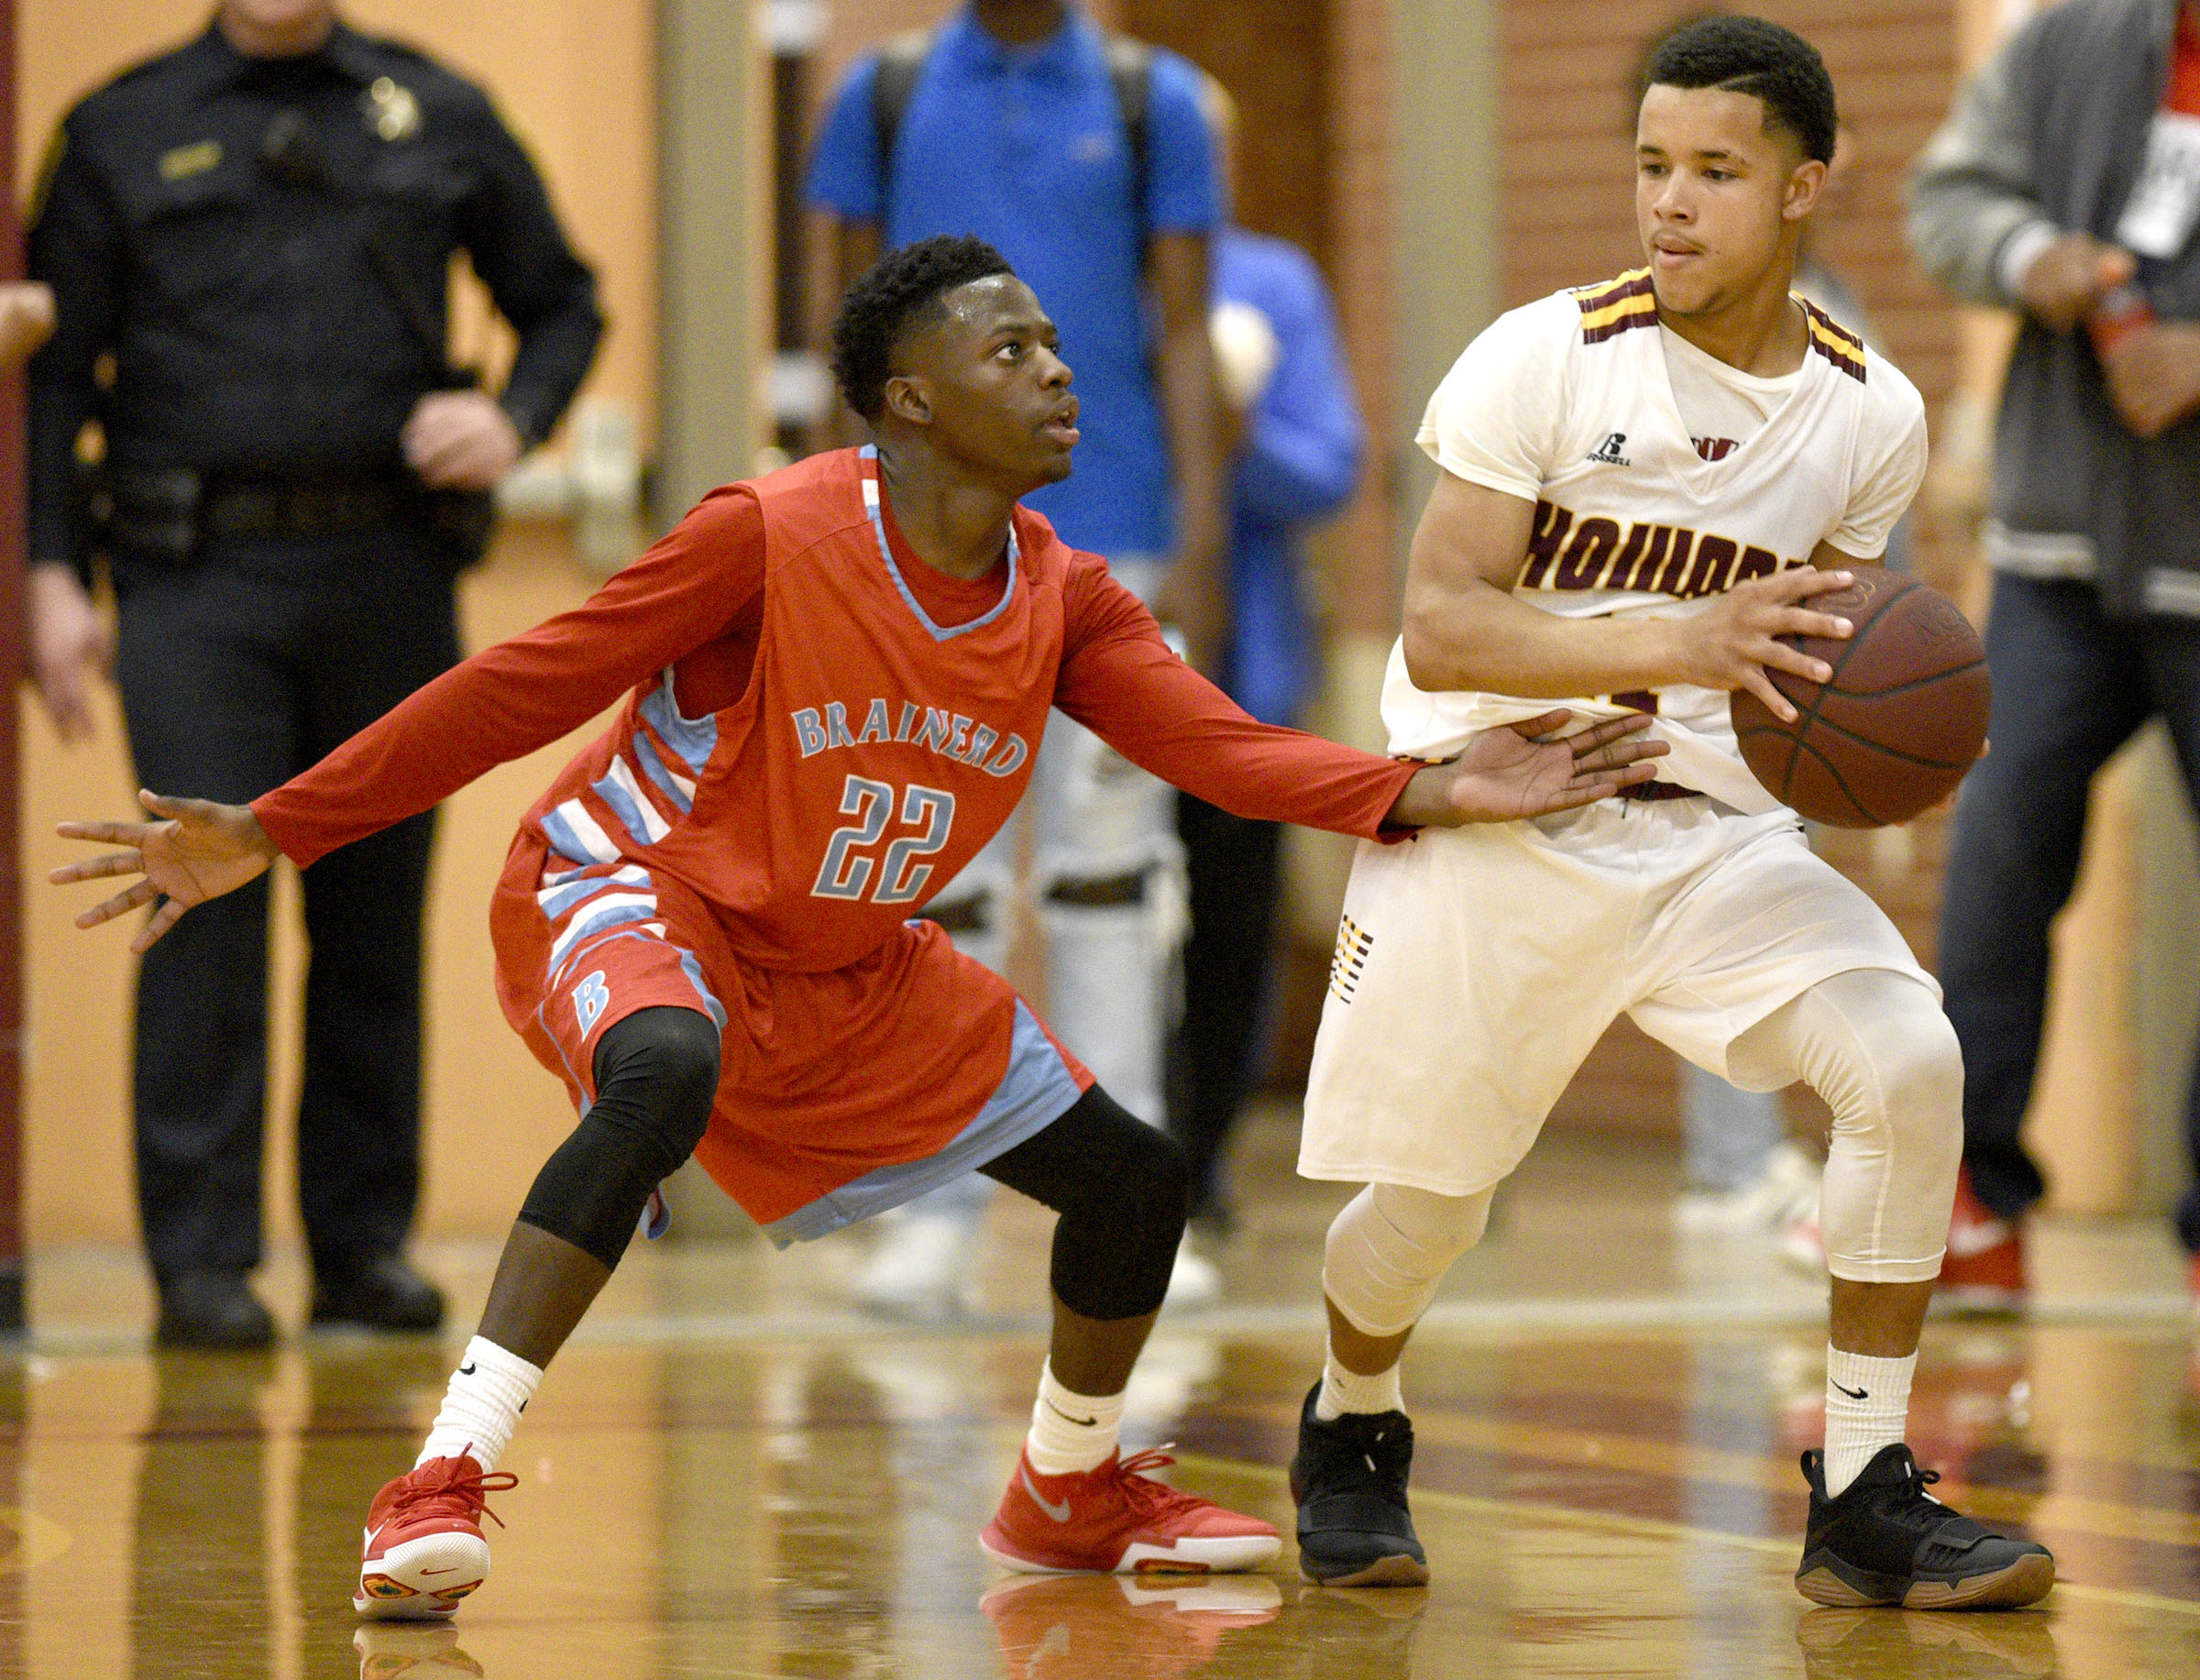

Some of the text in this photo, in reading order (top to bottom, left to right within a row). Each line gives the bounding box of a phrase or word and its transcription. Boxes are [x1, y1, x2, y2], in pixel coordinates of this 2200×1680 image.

[791, 697, 1028, 777] BRAINERD
[810, 774, 955, 904] 22
[571, 970, 610, 1043] B
